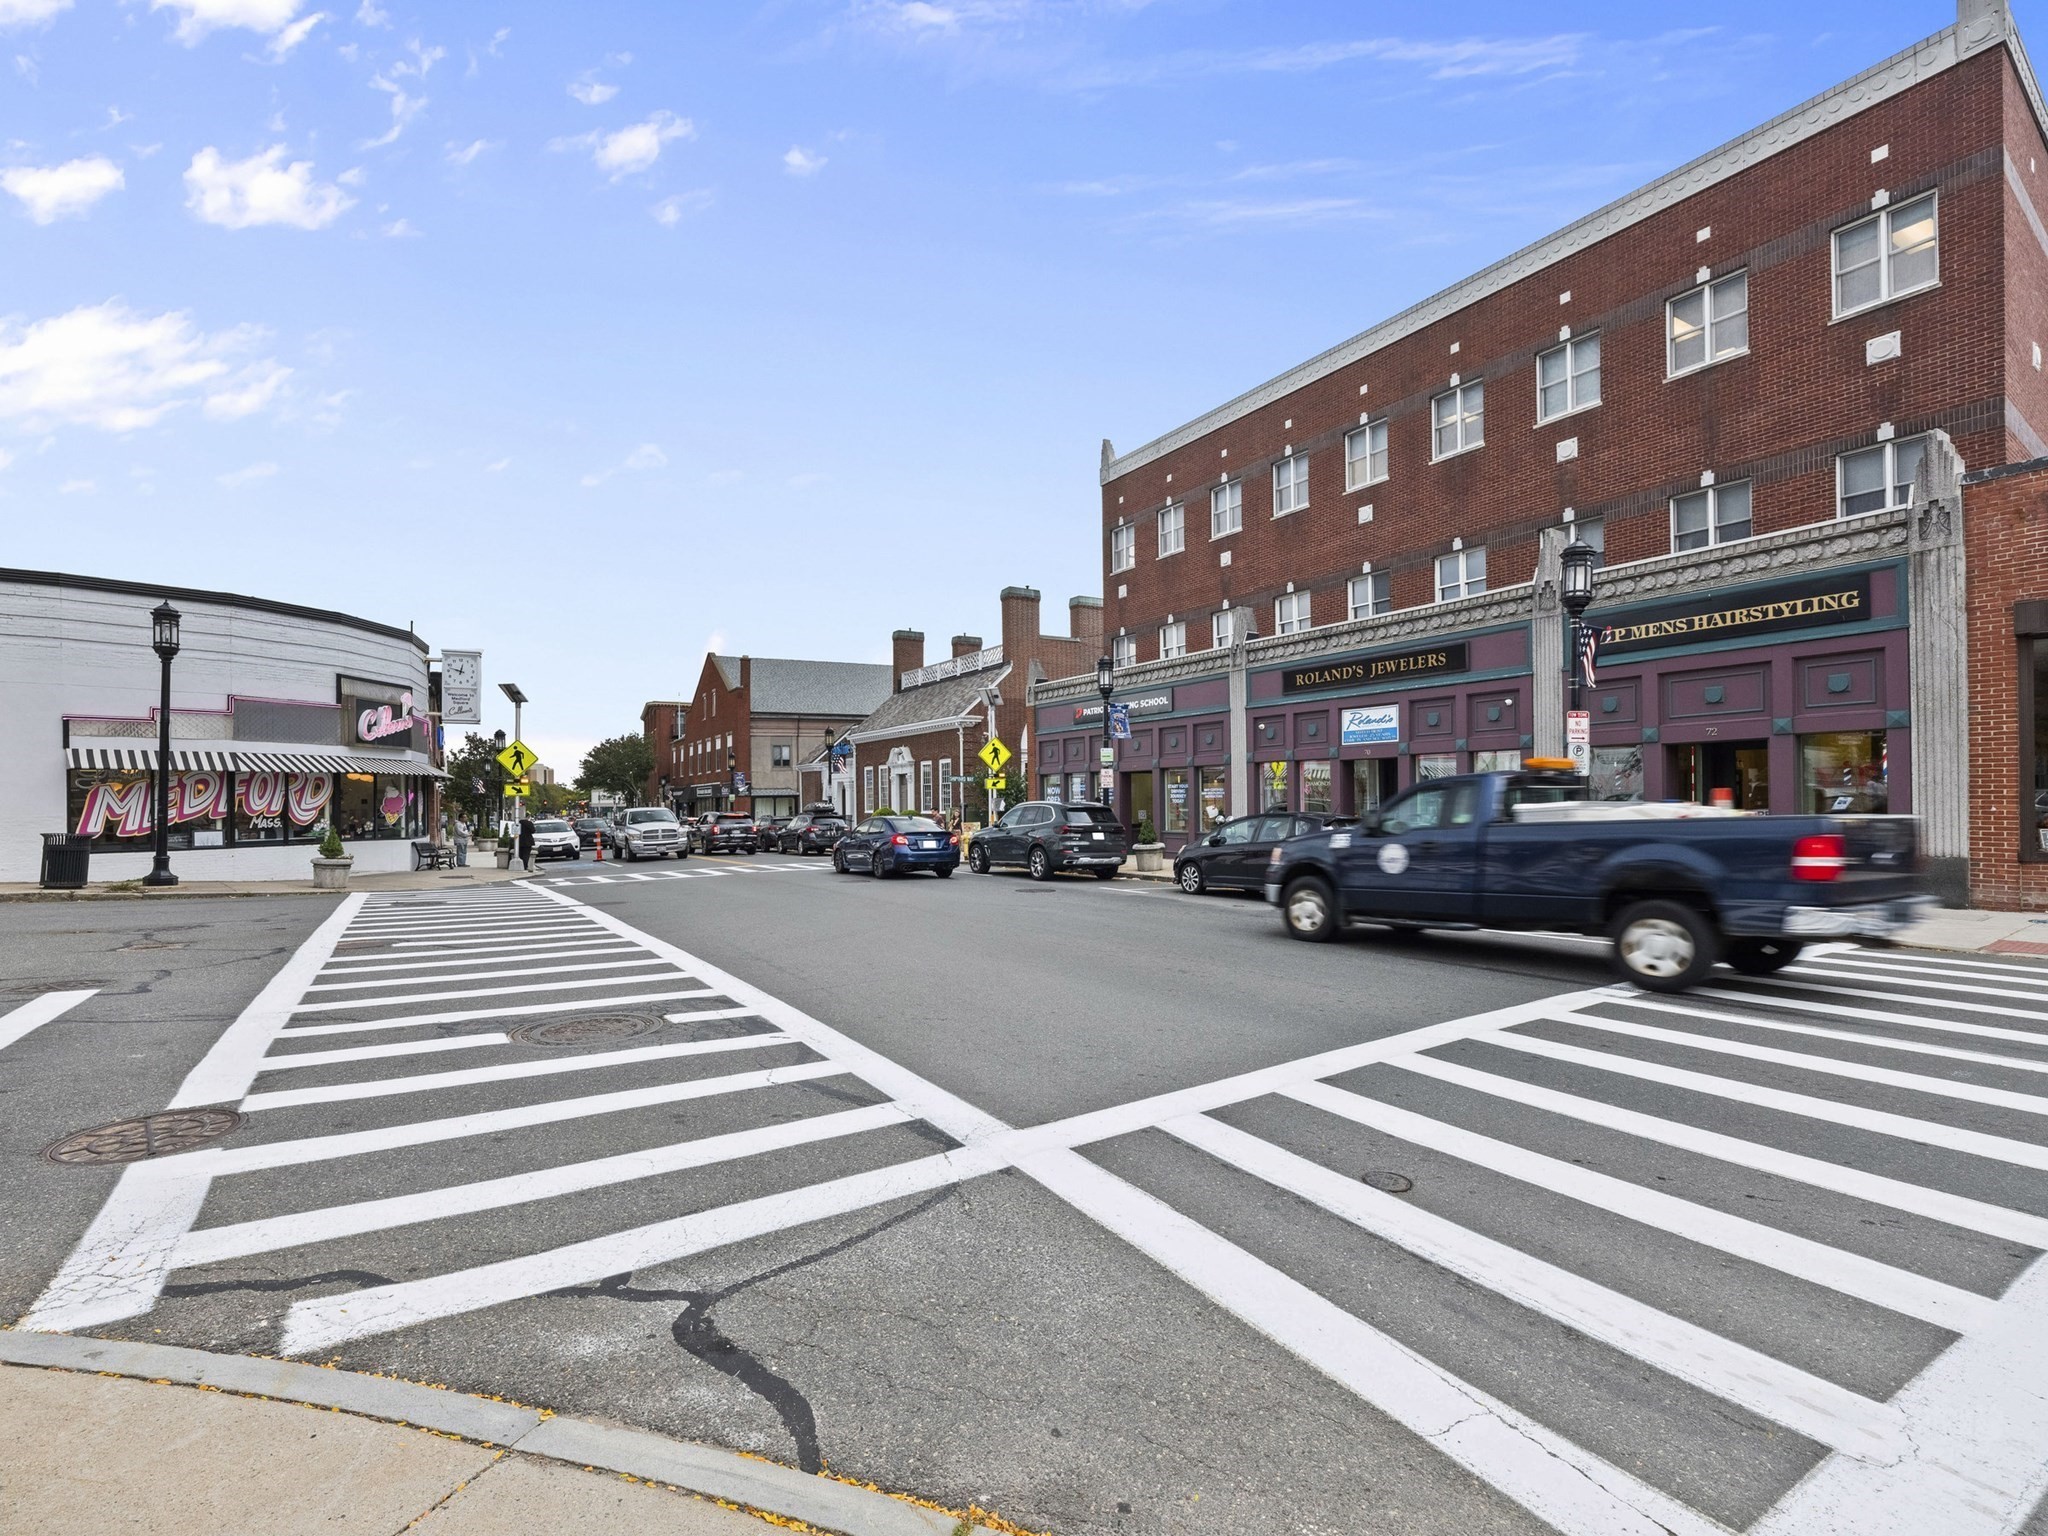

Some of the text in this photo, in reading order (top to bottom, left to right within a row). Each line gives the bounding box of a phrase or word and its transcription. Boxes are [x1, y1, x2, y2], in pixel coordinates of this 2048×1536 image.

[1631, 617, 1687, 640] MENS
[1690, 591, 1859, 631] HAIRSTYLING
[1296, 652, 1446, 686] ROLAND'S JEWELERS
[1140, 696, 1168, 708] SCHOOL
[1346, 712, 1394, 730] Roland's
[1705, 727, 1717, 736] 72
